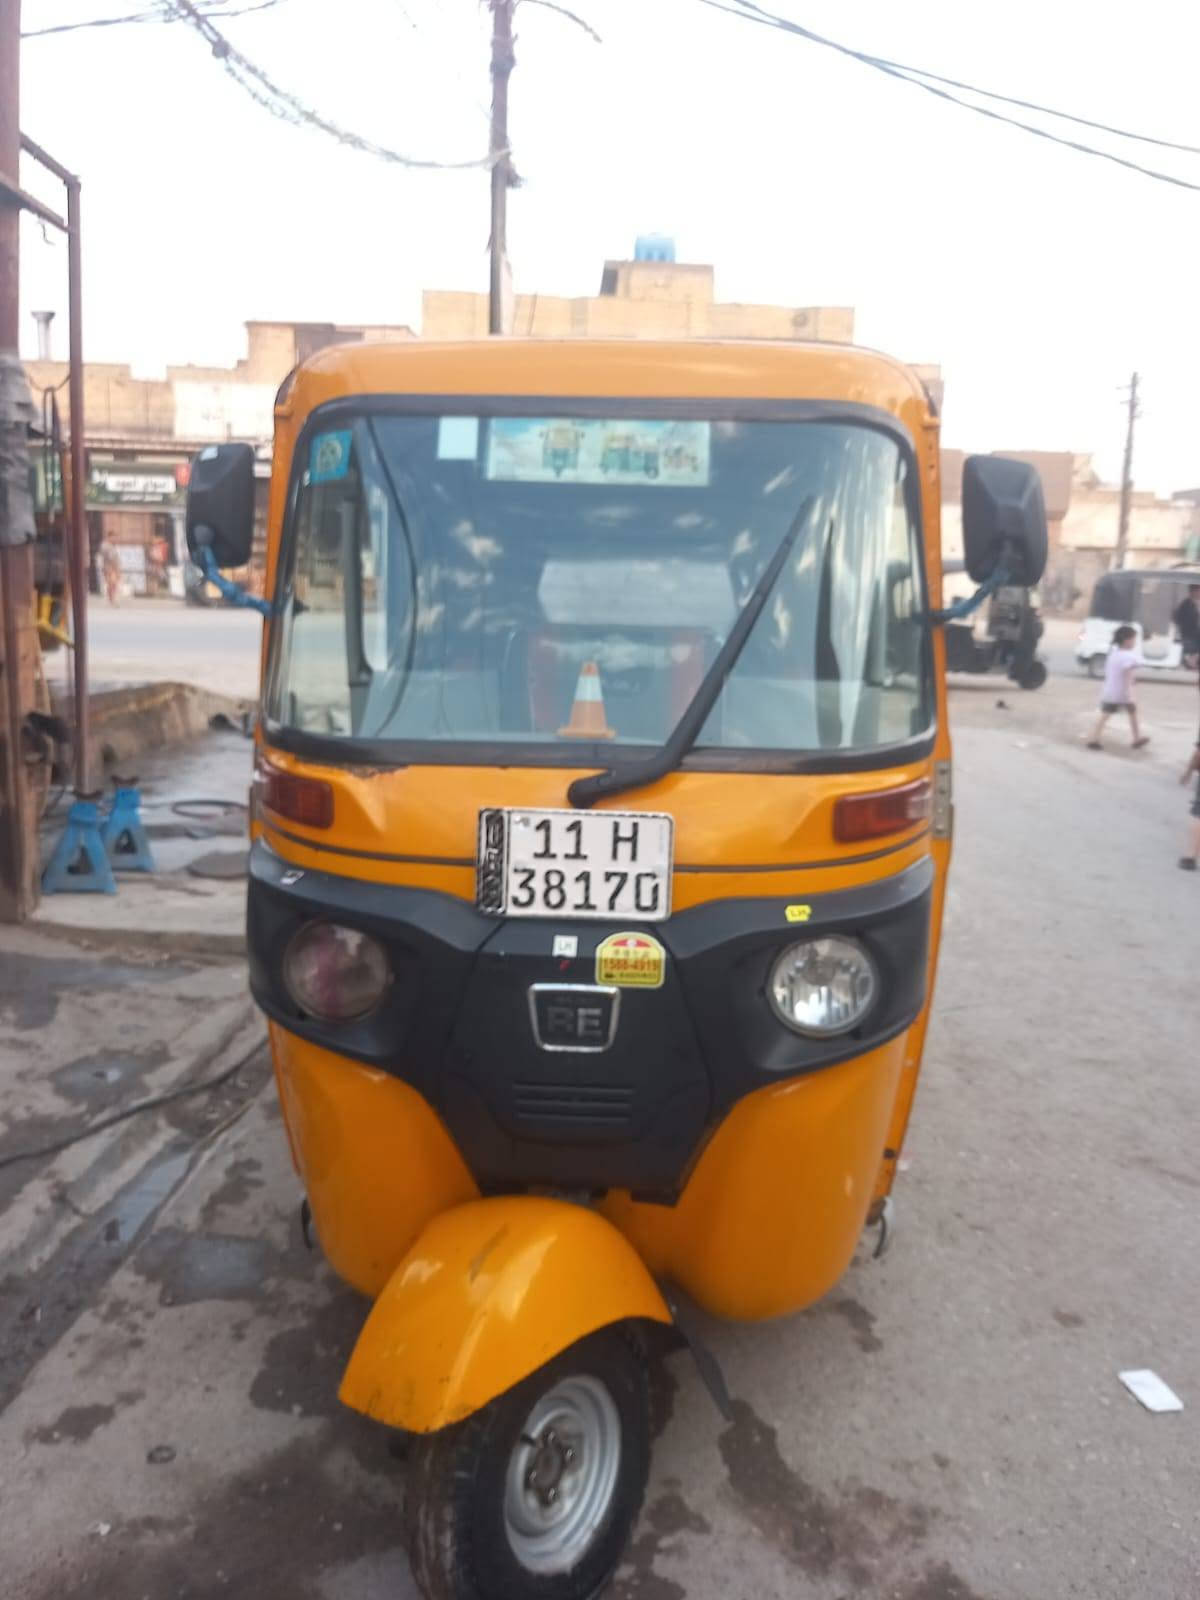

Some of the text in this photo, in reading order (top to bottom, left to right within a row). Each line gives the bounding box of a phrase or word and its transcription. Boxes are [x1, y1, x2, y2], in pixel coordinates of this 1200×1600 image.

[533, 819, 588, 860] 11
[611, 821, 640, 862] H
[511, 868, 660, 912] 38170
[546, 1007, 603, 1037] RE
